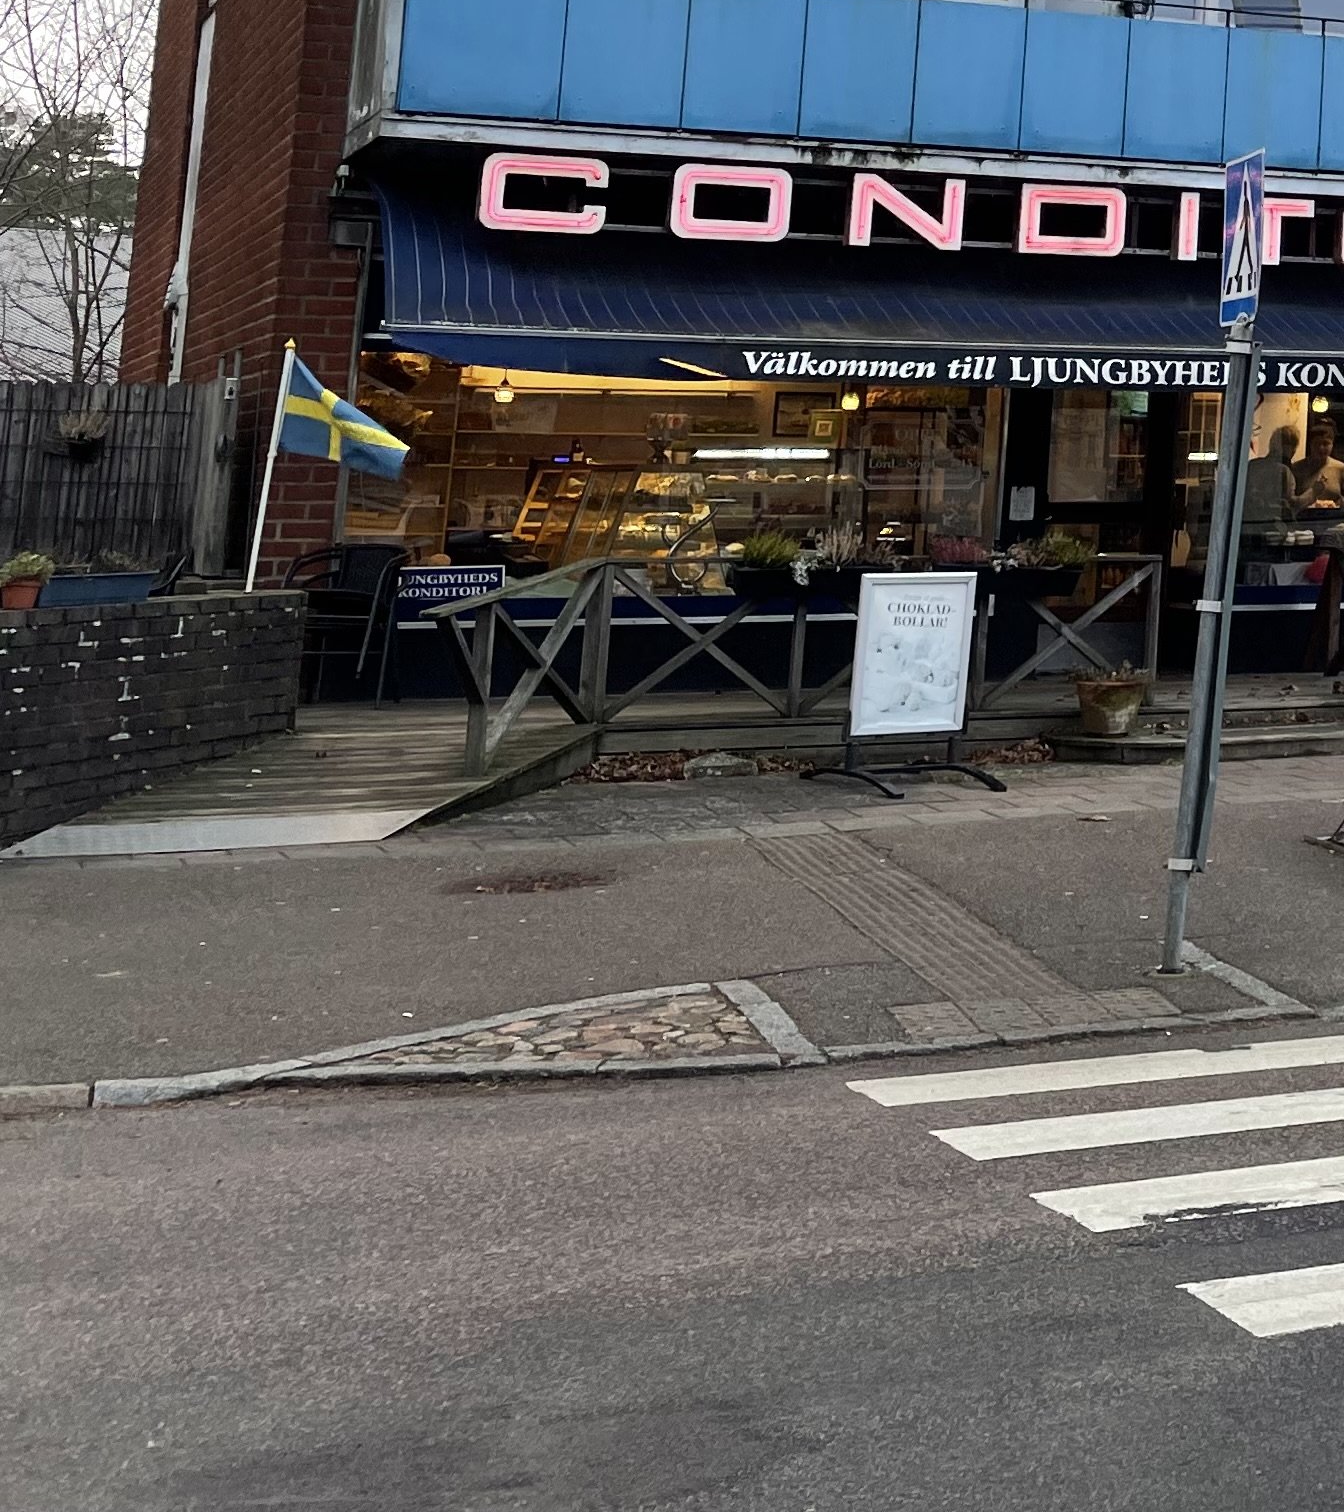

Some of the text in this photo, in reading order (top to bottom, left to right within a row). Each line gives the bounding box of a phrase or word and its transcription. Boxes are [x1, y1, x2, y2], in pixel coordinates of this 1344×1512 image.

[742, 351, 937, 380] Välkommen
[947, 355, 997, 381] till
[397, 572, 499, 587] JUNGBYHEDS
[398, 585, 487, 599] KONDITORI
[887, 601, 958, 615] CHOKLAD-
